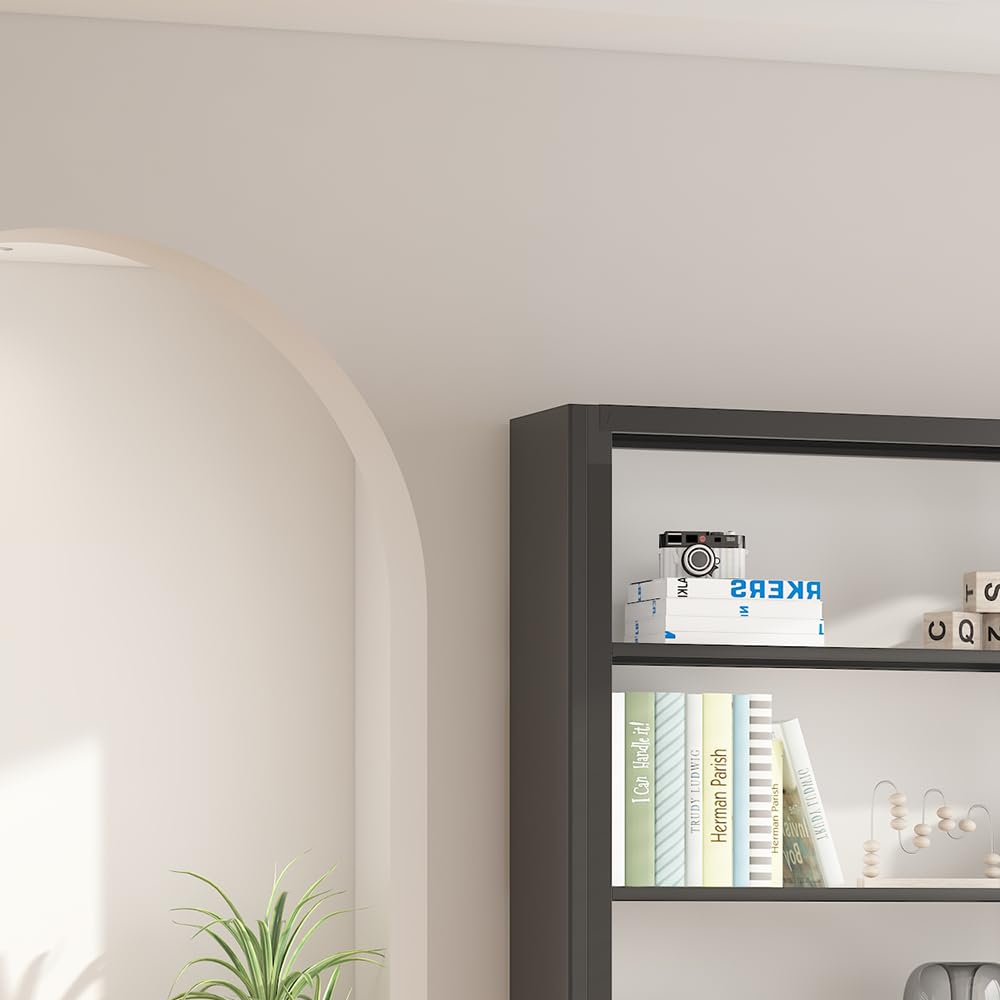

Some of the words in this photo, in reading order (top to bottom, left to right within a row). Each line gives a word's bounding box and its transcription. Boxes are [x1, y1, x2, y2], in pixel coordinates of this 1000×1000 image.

[928, 621, 946, 640] C
[959, 619, 974, 644] Q
[629, 721, 650, 736] it!
[632, 738, 650, 769] Handle
[710, 748, 727, 786] Parish
[634, 776, 650, 797] Can
[690, 750, 700, 794] LUDWIG
[690, 798, 700, 834] TRUDY
[711, 792, 727, 842] Herman
